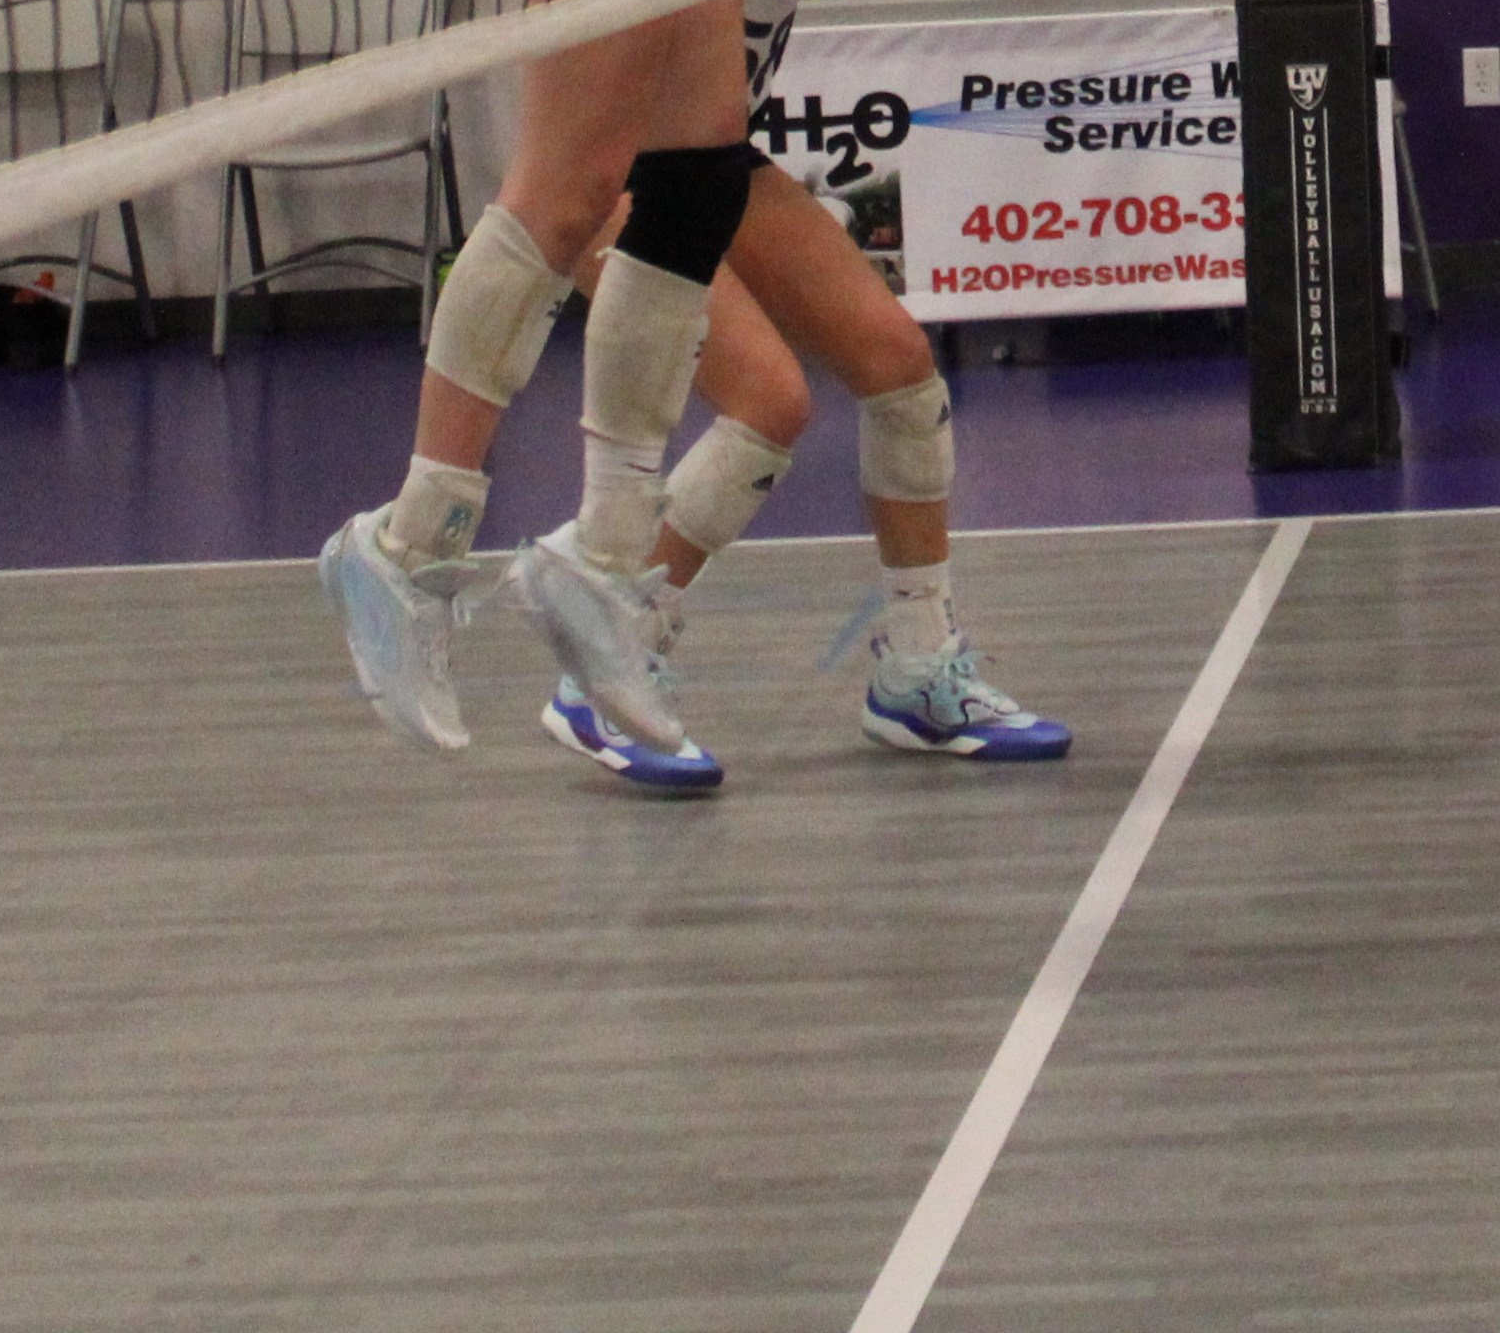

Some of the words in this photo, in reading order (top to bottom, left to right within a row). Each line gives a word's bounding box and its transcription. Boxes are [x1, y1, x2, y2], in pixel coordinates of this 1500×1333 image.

[960, 70, 1192, 113] Pressure
[1043, 108, 1237, 154] Service
[961, 191, 1244, 245] 402-708-3
